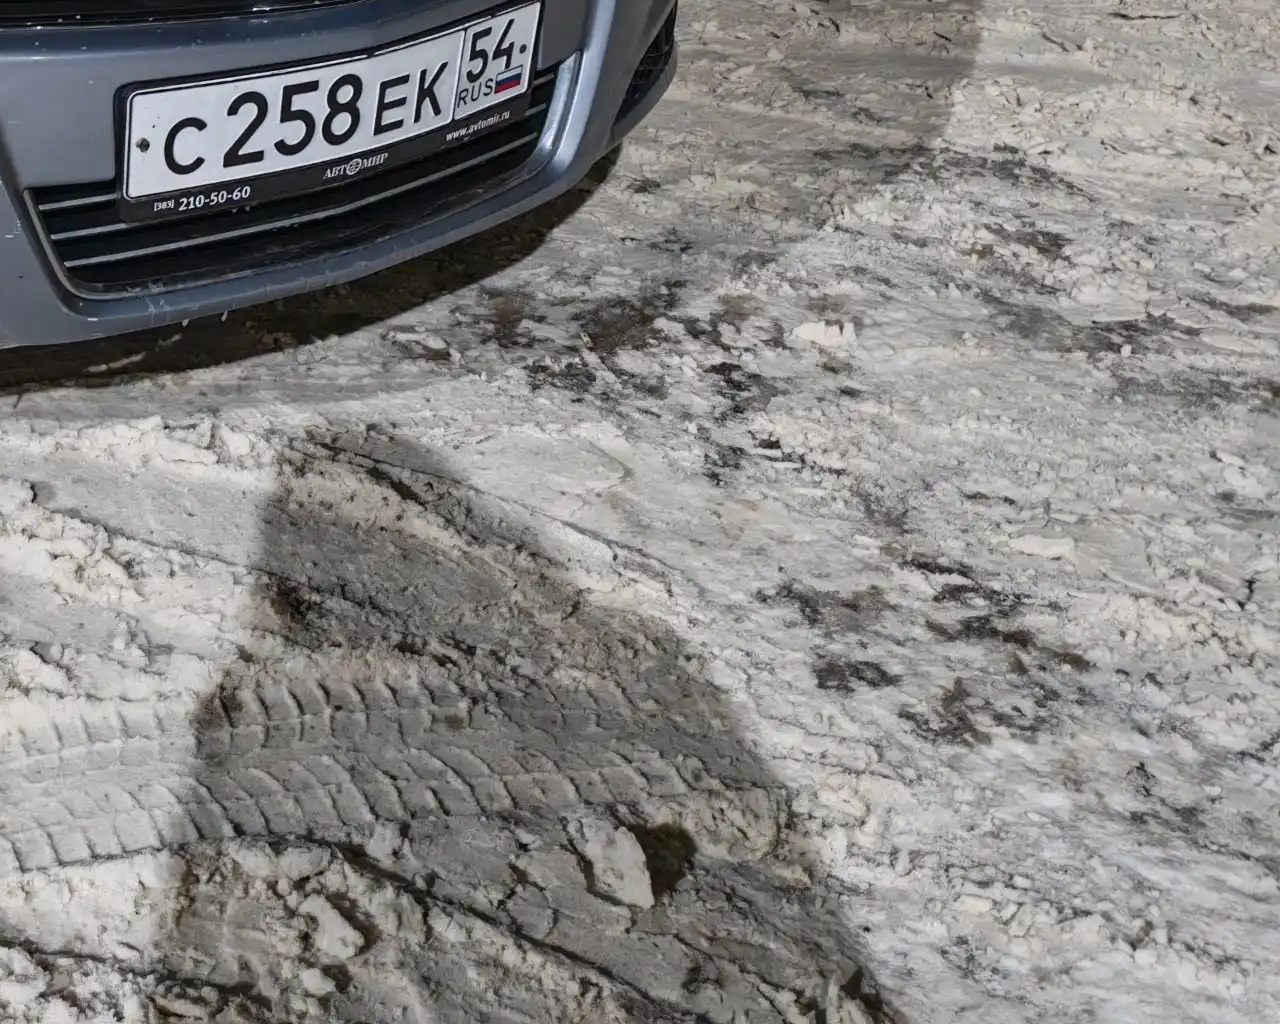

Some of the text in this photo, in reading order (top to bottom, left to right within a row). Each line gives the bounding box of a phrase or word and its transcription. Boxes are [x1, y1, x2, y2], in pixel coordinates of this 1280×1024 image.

[467, 18, 516, 79] 54
[456, 77, 494, 109] RUS
[445, 110, 511, 142] www.avtomir.ru
[178, 186, 251, 211] 210-50-60
